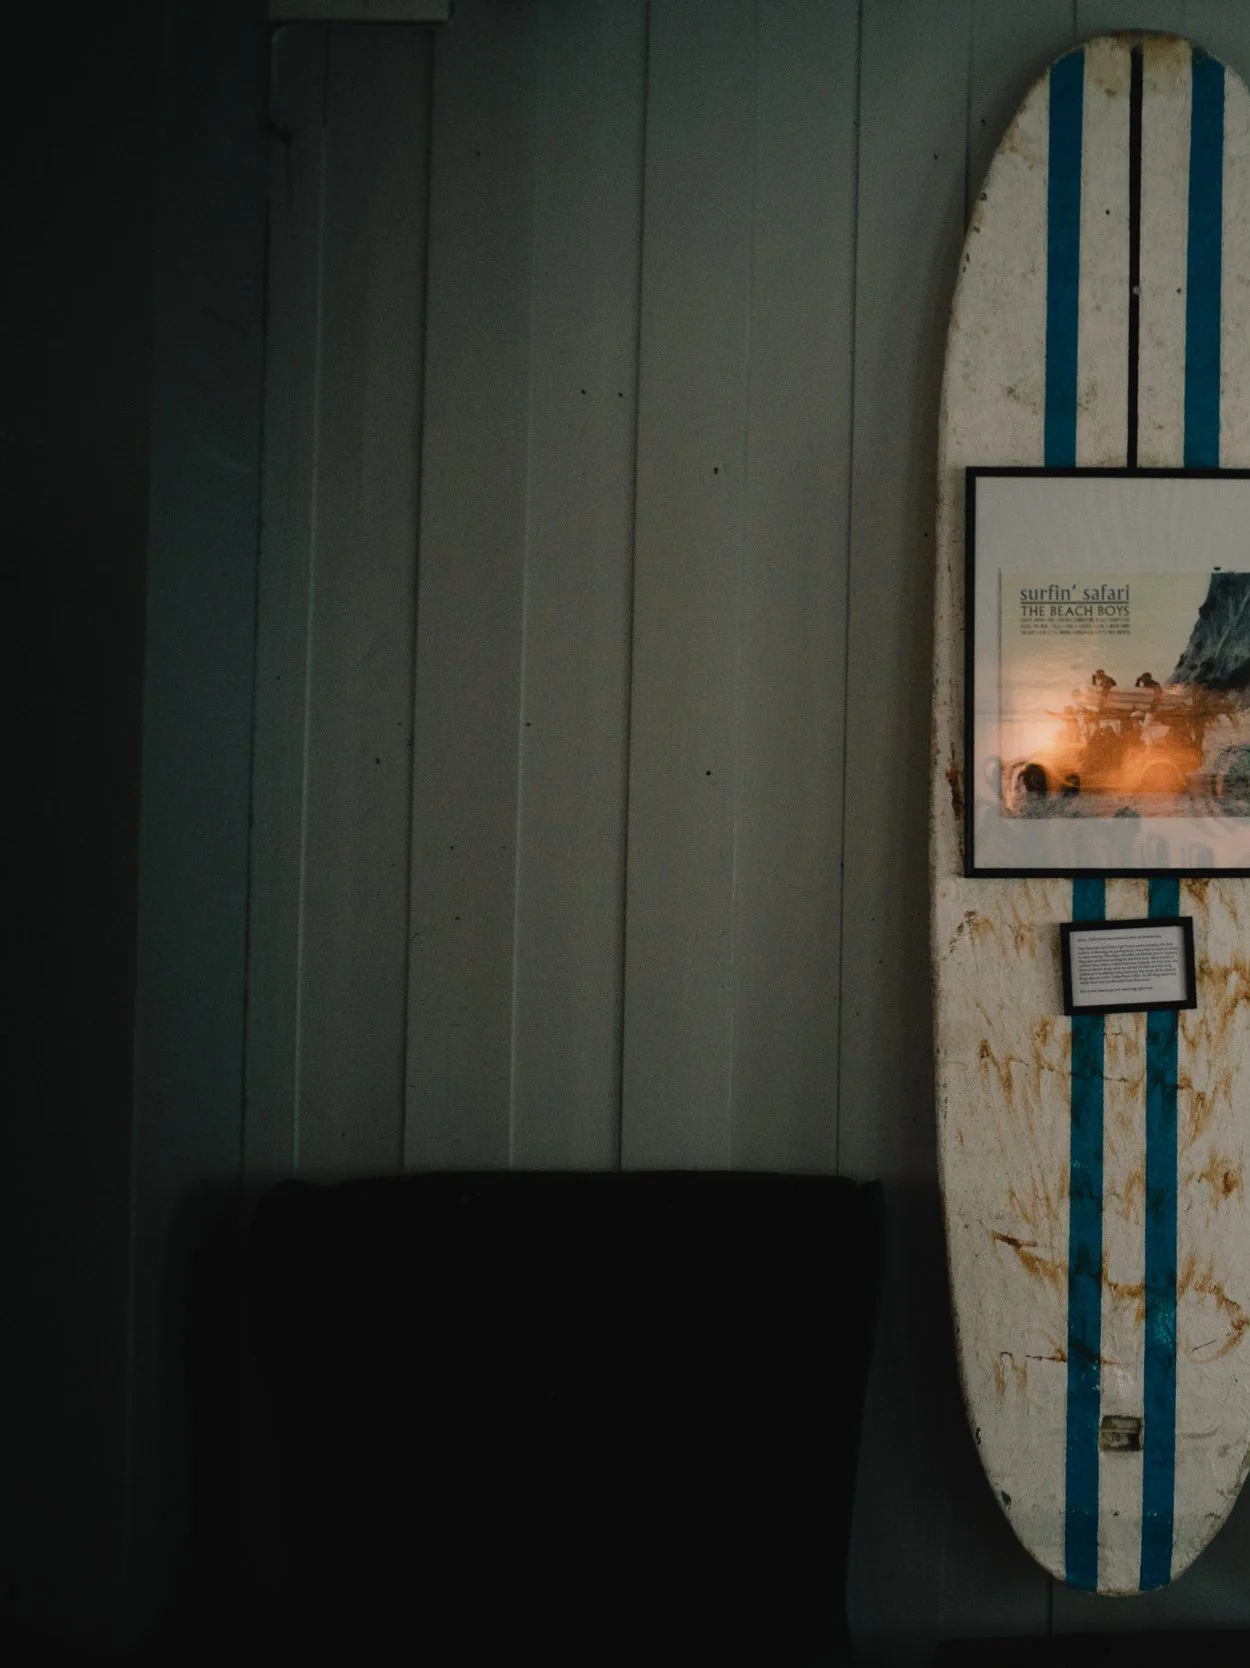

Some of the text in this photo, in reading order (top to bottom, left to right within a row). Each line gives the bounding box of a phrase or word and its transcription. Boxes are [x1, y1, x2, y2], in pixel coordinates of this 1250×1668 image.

[1020, 584, 1130, 601] surfin' safari
[1020, 605, 1130, 617] THE BEACH BOYS
